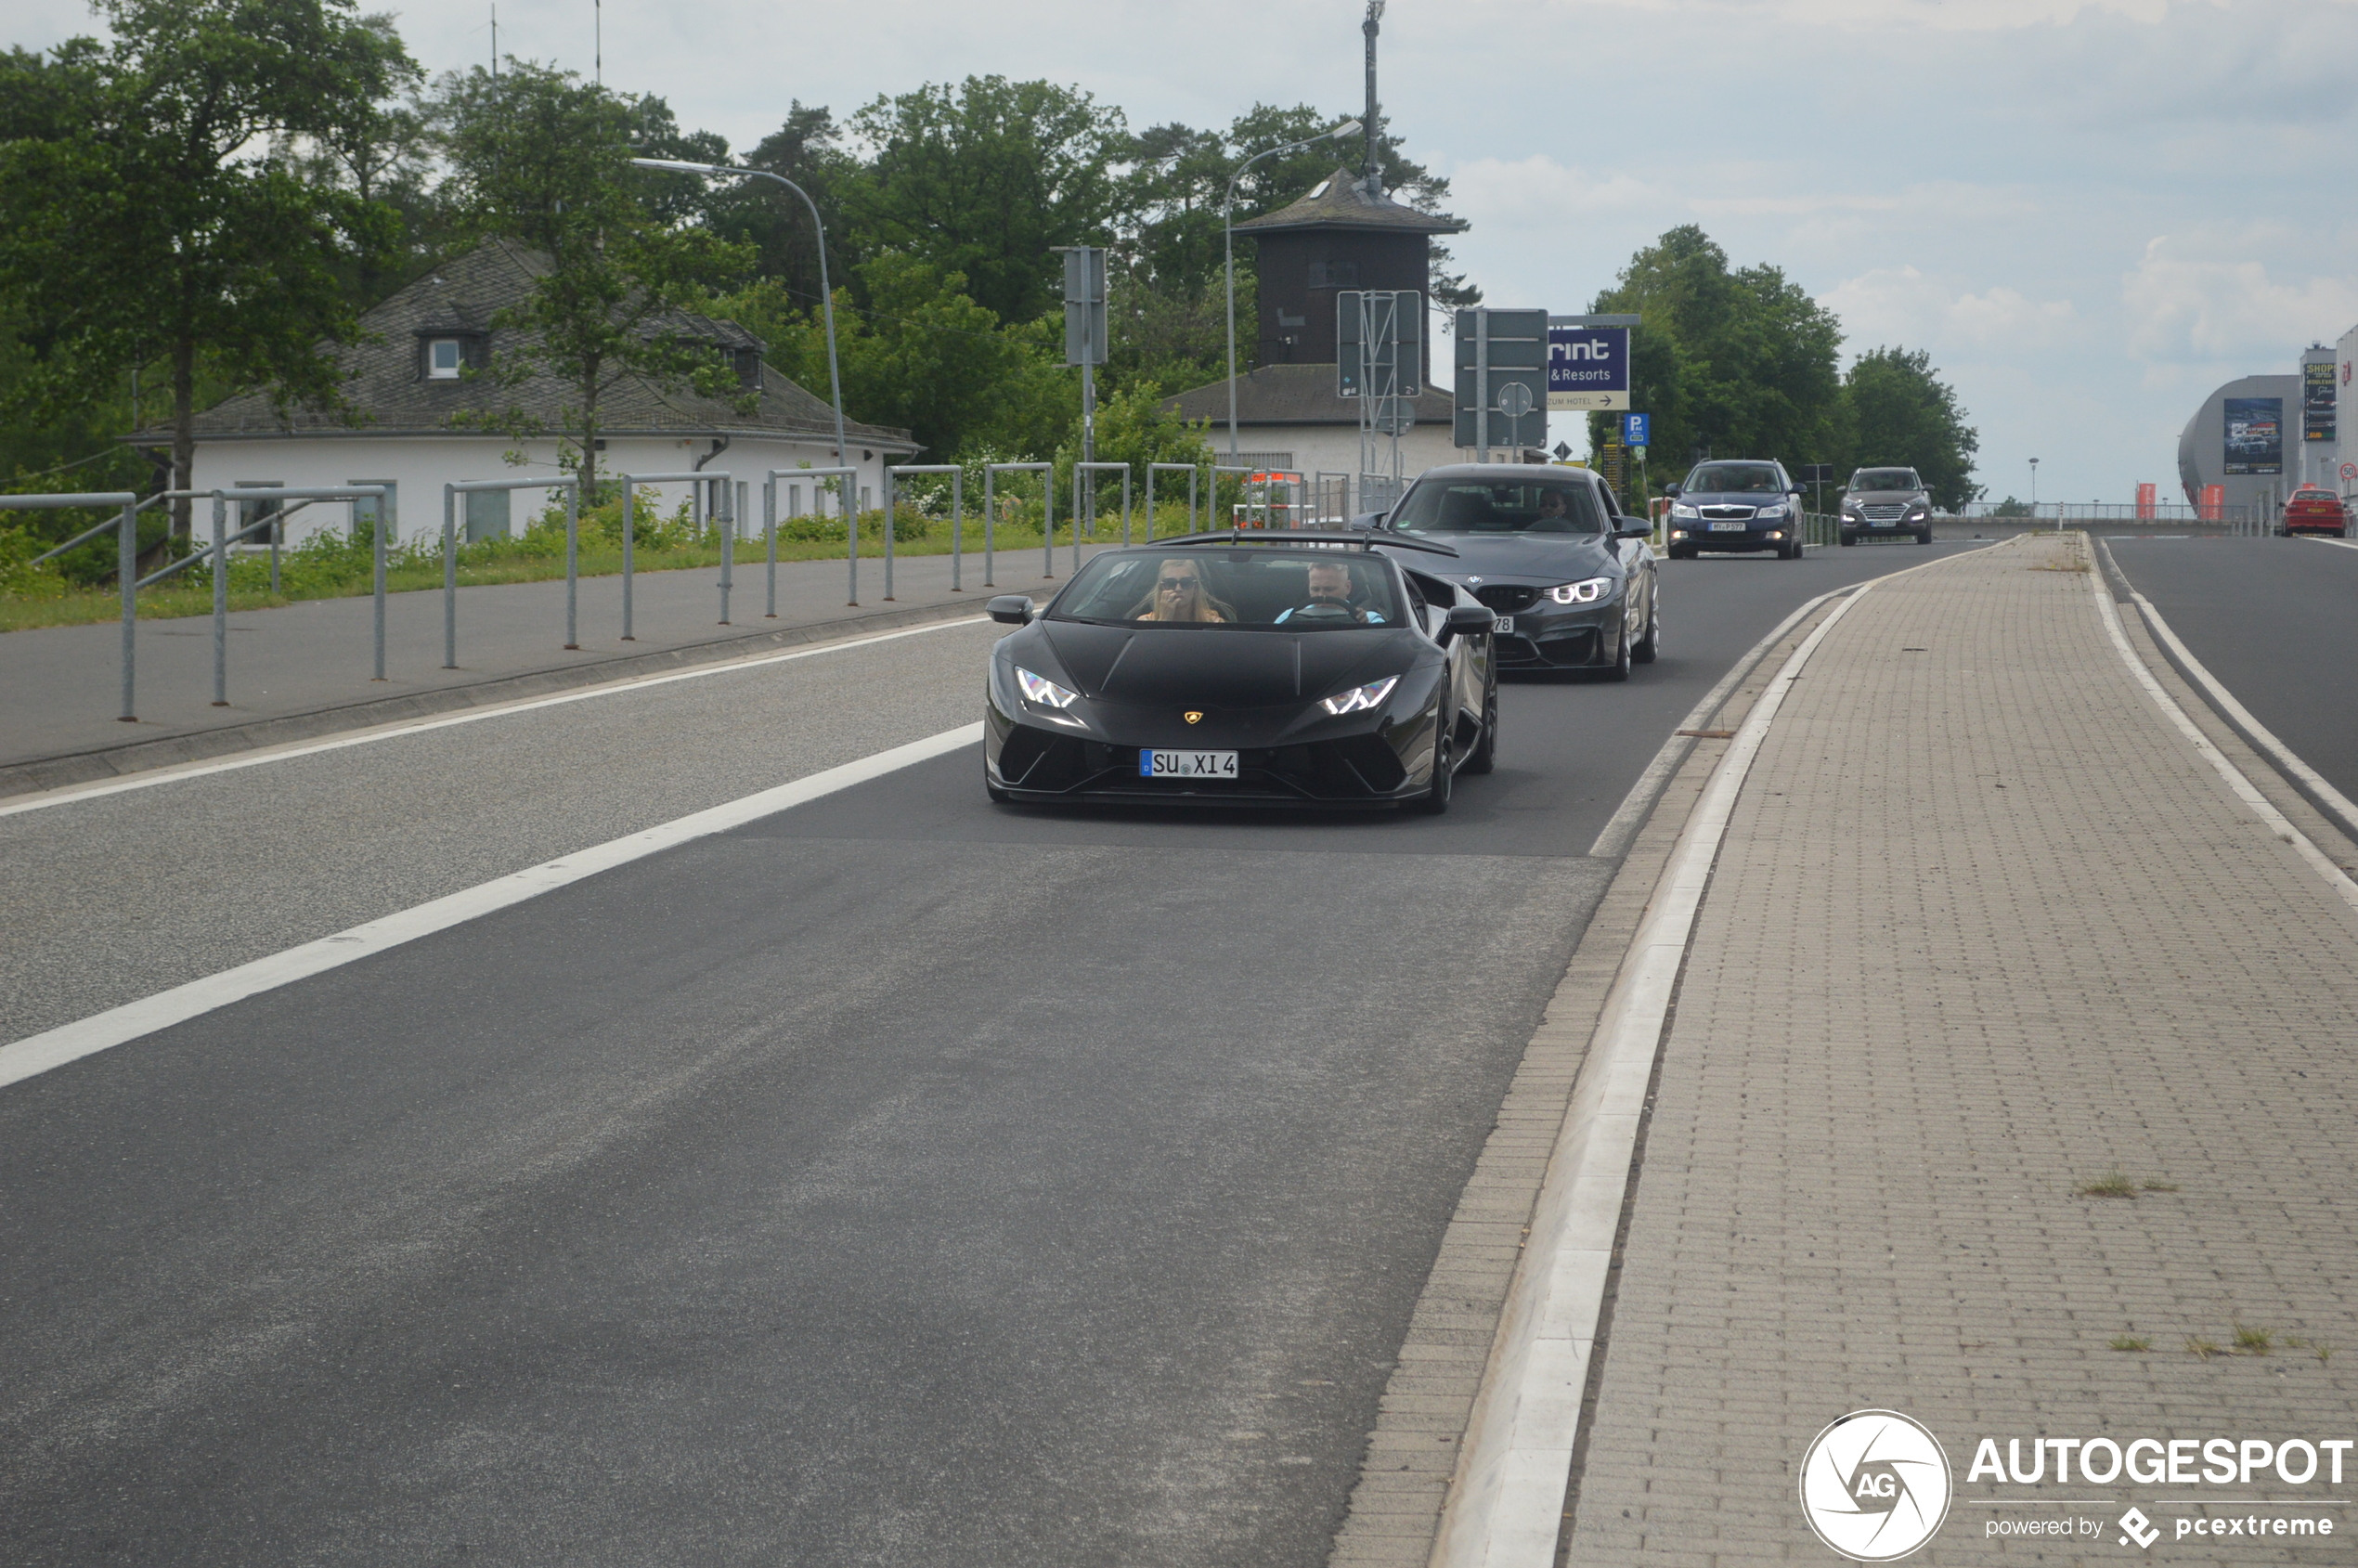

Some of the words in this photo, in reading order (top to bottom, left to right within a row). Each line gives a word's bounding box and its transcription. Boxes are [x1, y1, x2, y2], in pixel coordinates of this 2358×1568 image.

[1551, 369, 1561, 381] &
[1562, 369, 1611, 381] Resorts
[1630, 416, 1642, 431] P
[2343, 467, 2353, 475] 50
[1153, 754, 1178, 773] SU
